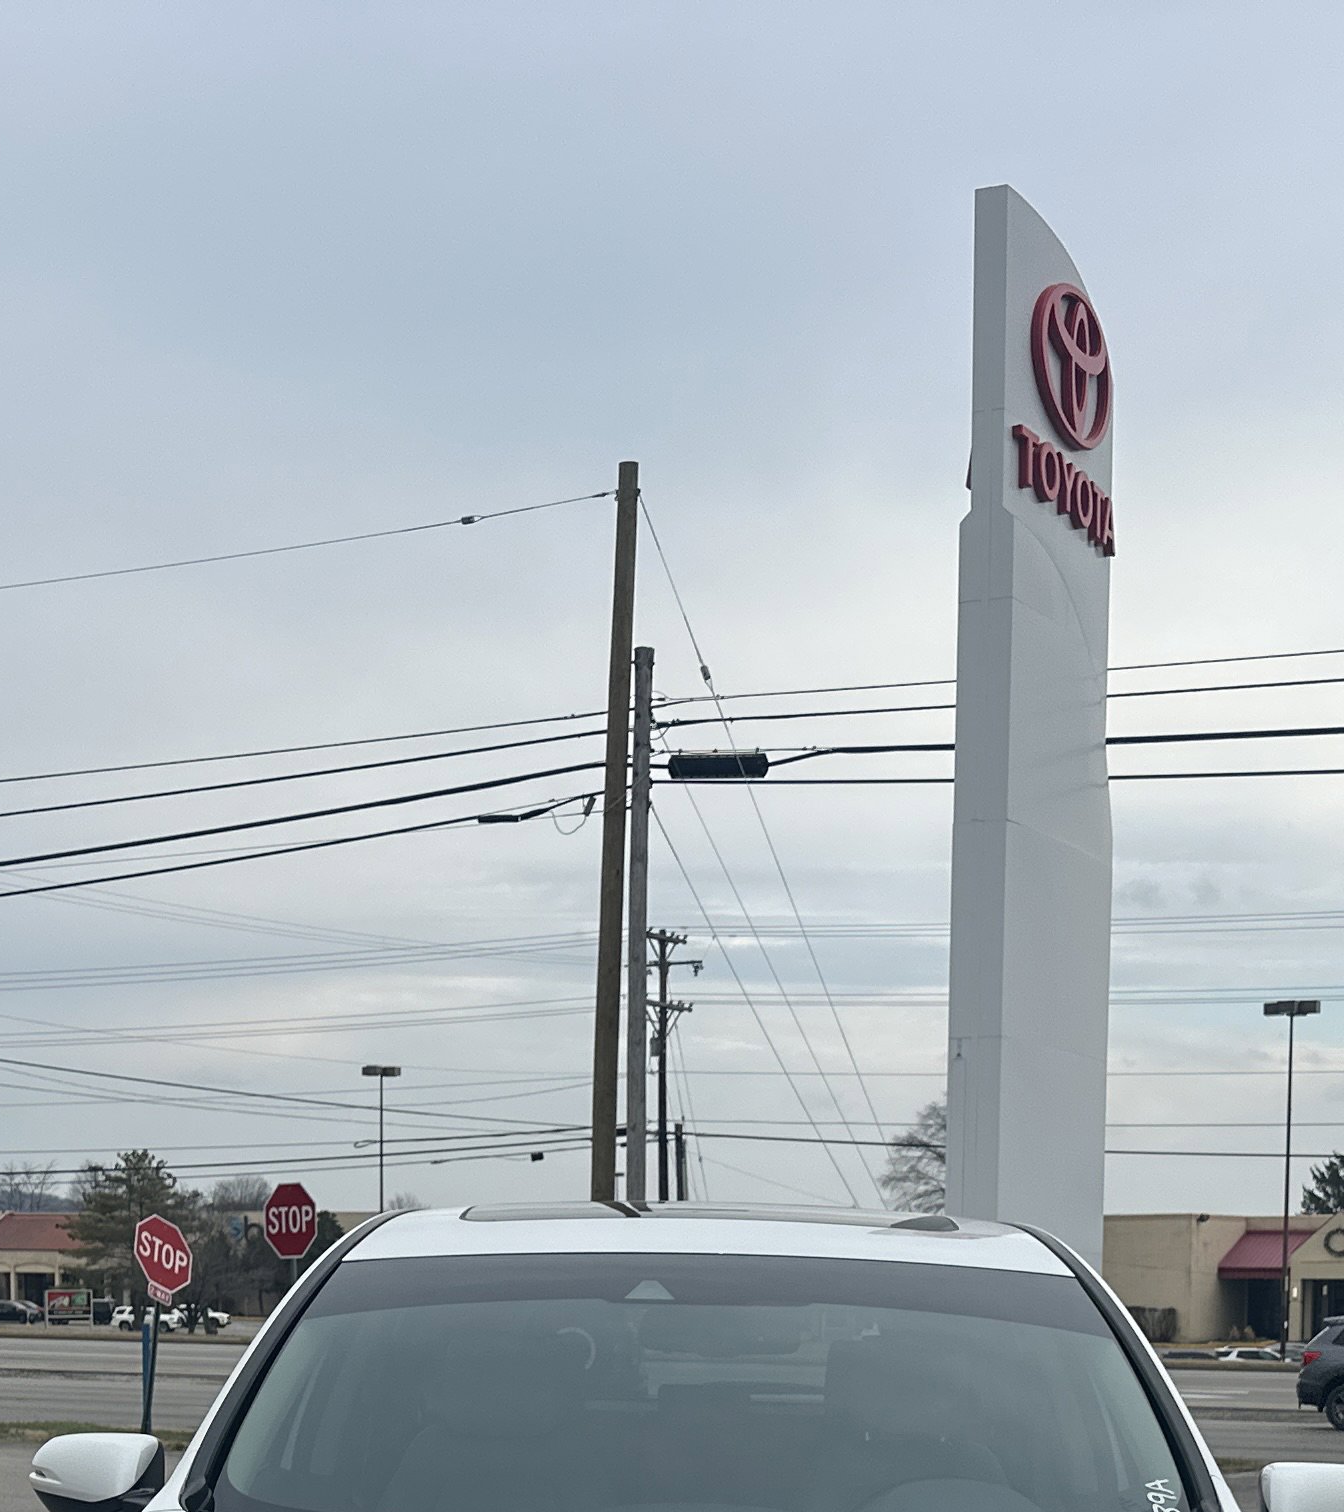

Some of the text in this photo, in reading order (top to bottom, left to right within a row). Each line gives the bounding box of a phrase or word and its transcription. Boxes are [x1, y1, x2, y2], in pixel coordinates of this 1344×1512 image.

[1012, 424, 1115, 557] TOYOTA
[268, 1205, 313, 1234] STOP
[139, 1231, 188, 1274] STOP
